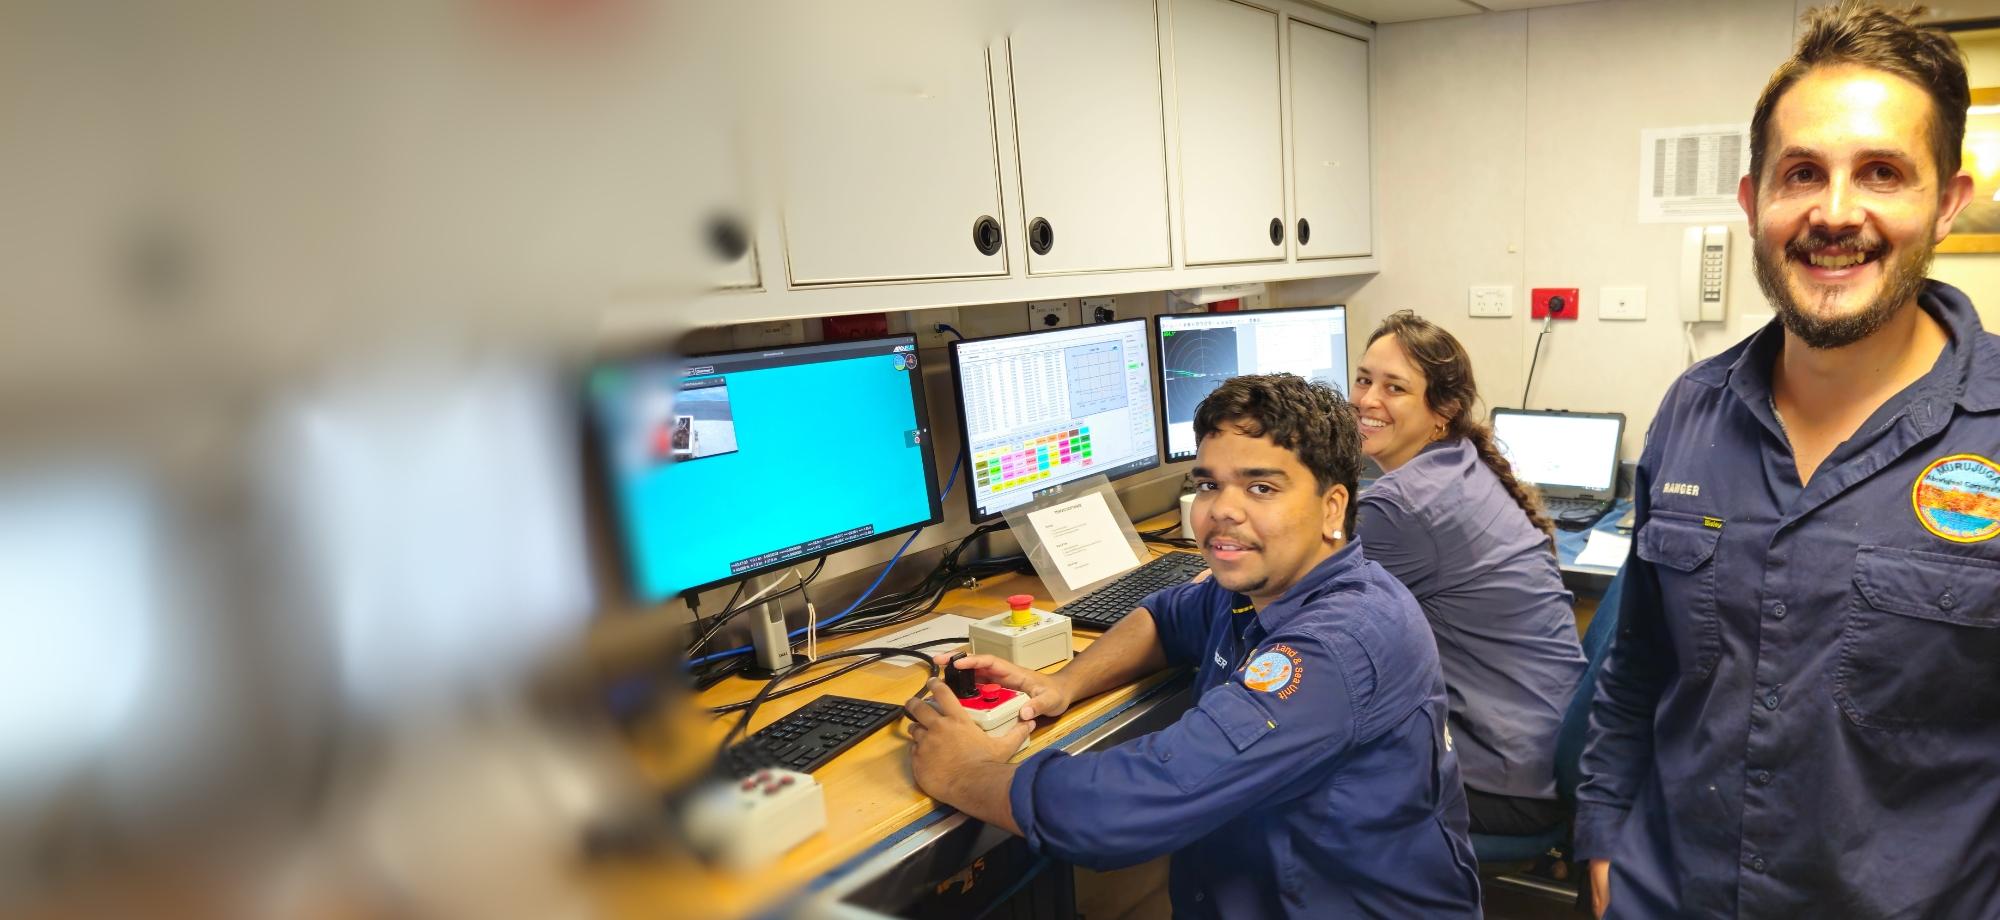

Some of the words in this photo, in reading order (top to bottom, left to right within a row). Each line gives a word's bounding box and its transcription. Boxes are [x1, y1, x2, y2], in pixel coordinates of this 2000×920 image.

[1663, 482, 1700, 496] RANGER
[1276, 643, 1298, 658] Land
[1278, 684, 1298, 700] Unit
